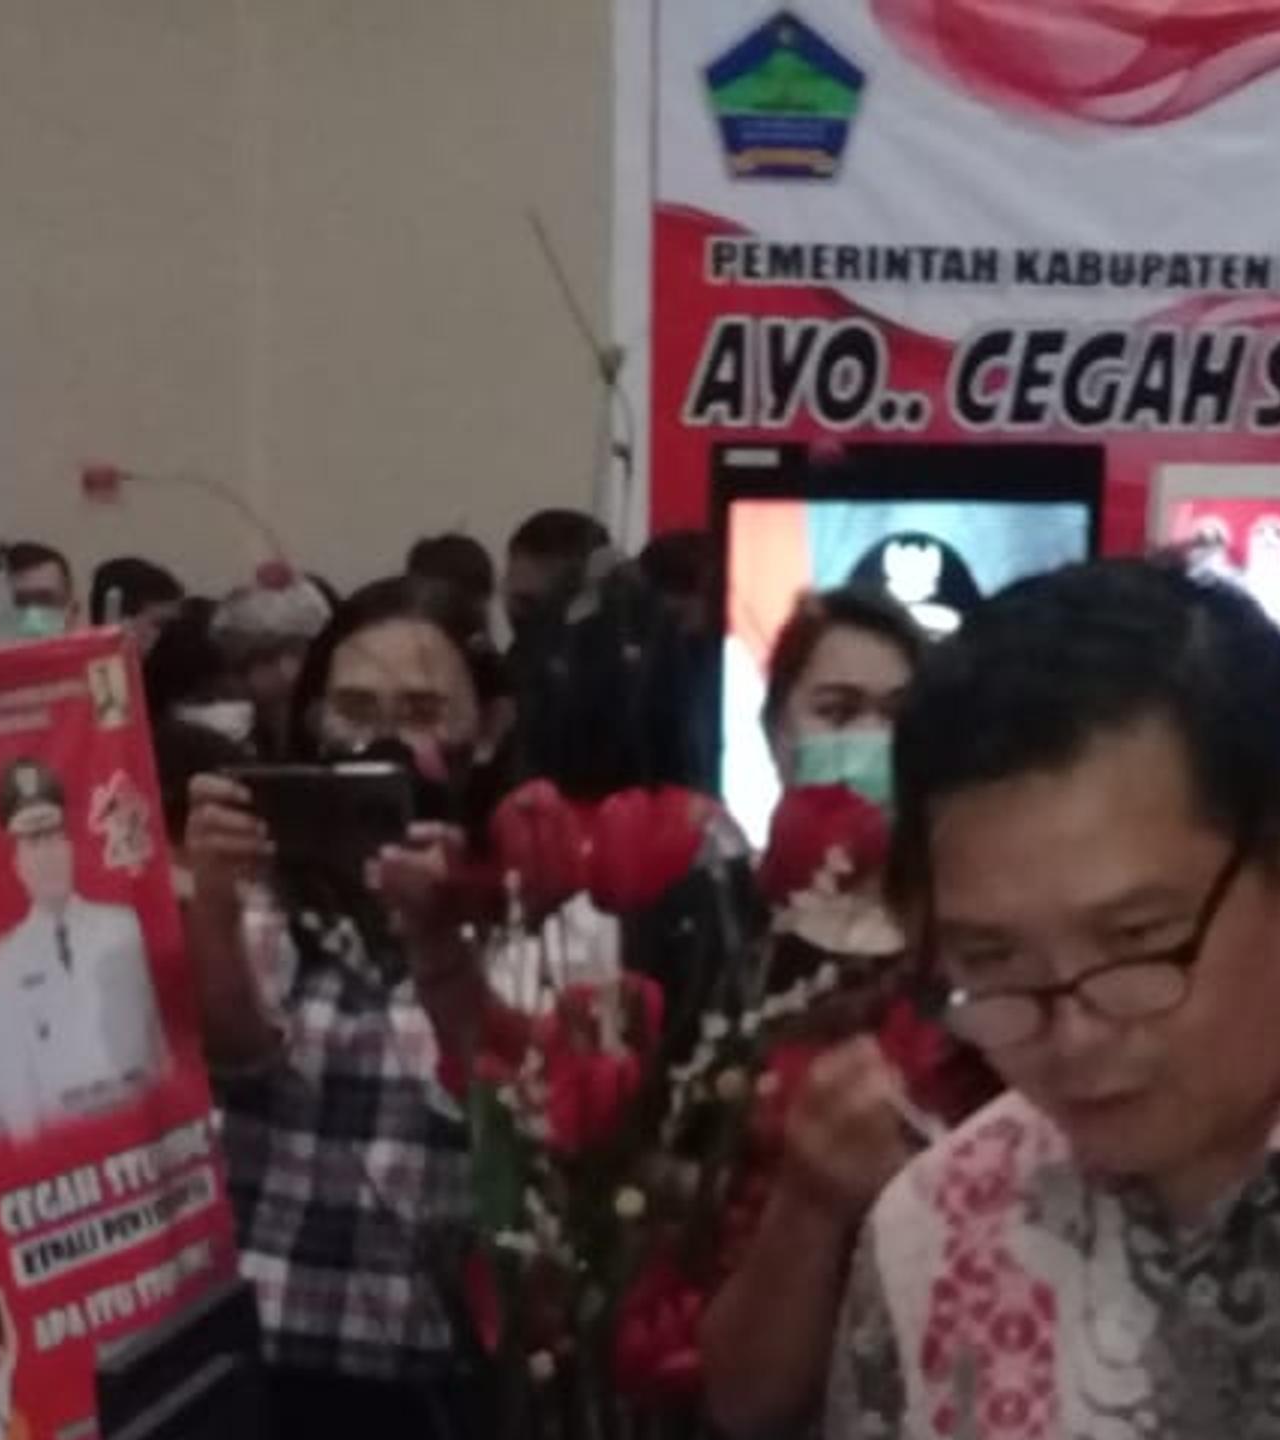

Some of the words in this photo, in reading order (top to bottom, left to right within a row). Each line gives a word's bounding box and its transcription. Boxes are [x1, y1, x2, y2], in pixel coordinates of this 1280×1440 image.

[710, 240, 1000, 285] PEMERINTAH
[1015, 248, 1271, 290] KABUPATEN
[690, 321, 924, 424] AYO..
[954, 329, 1248, 427] CEGAH
